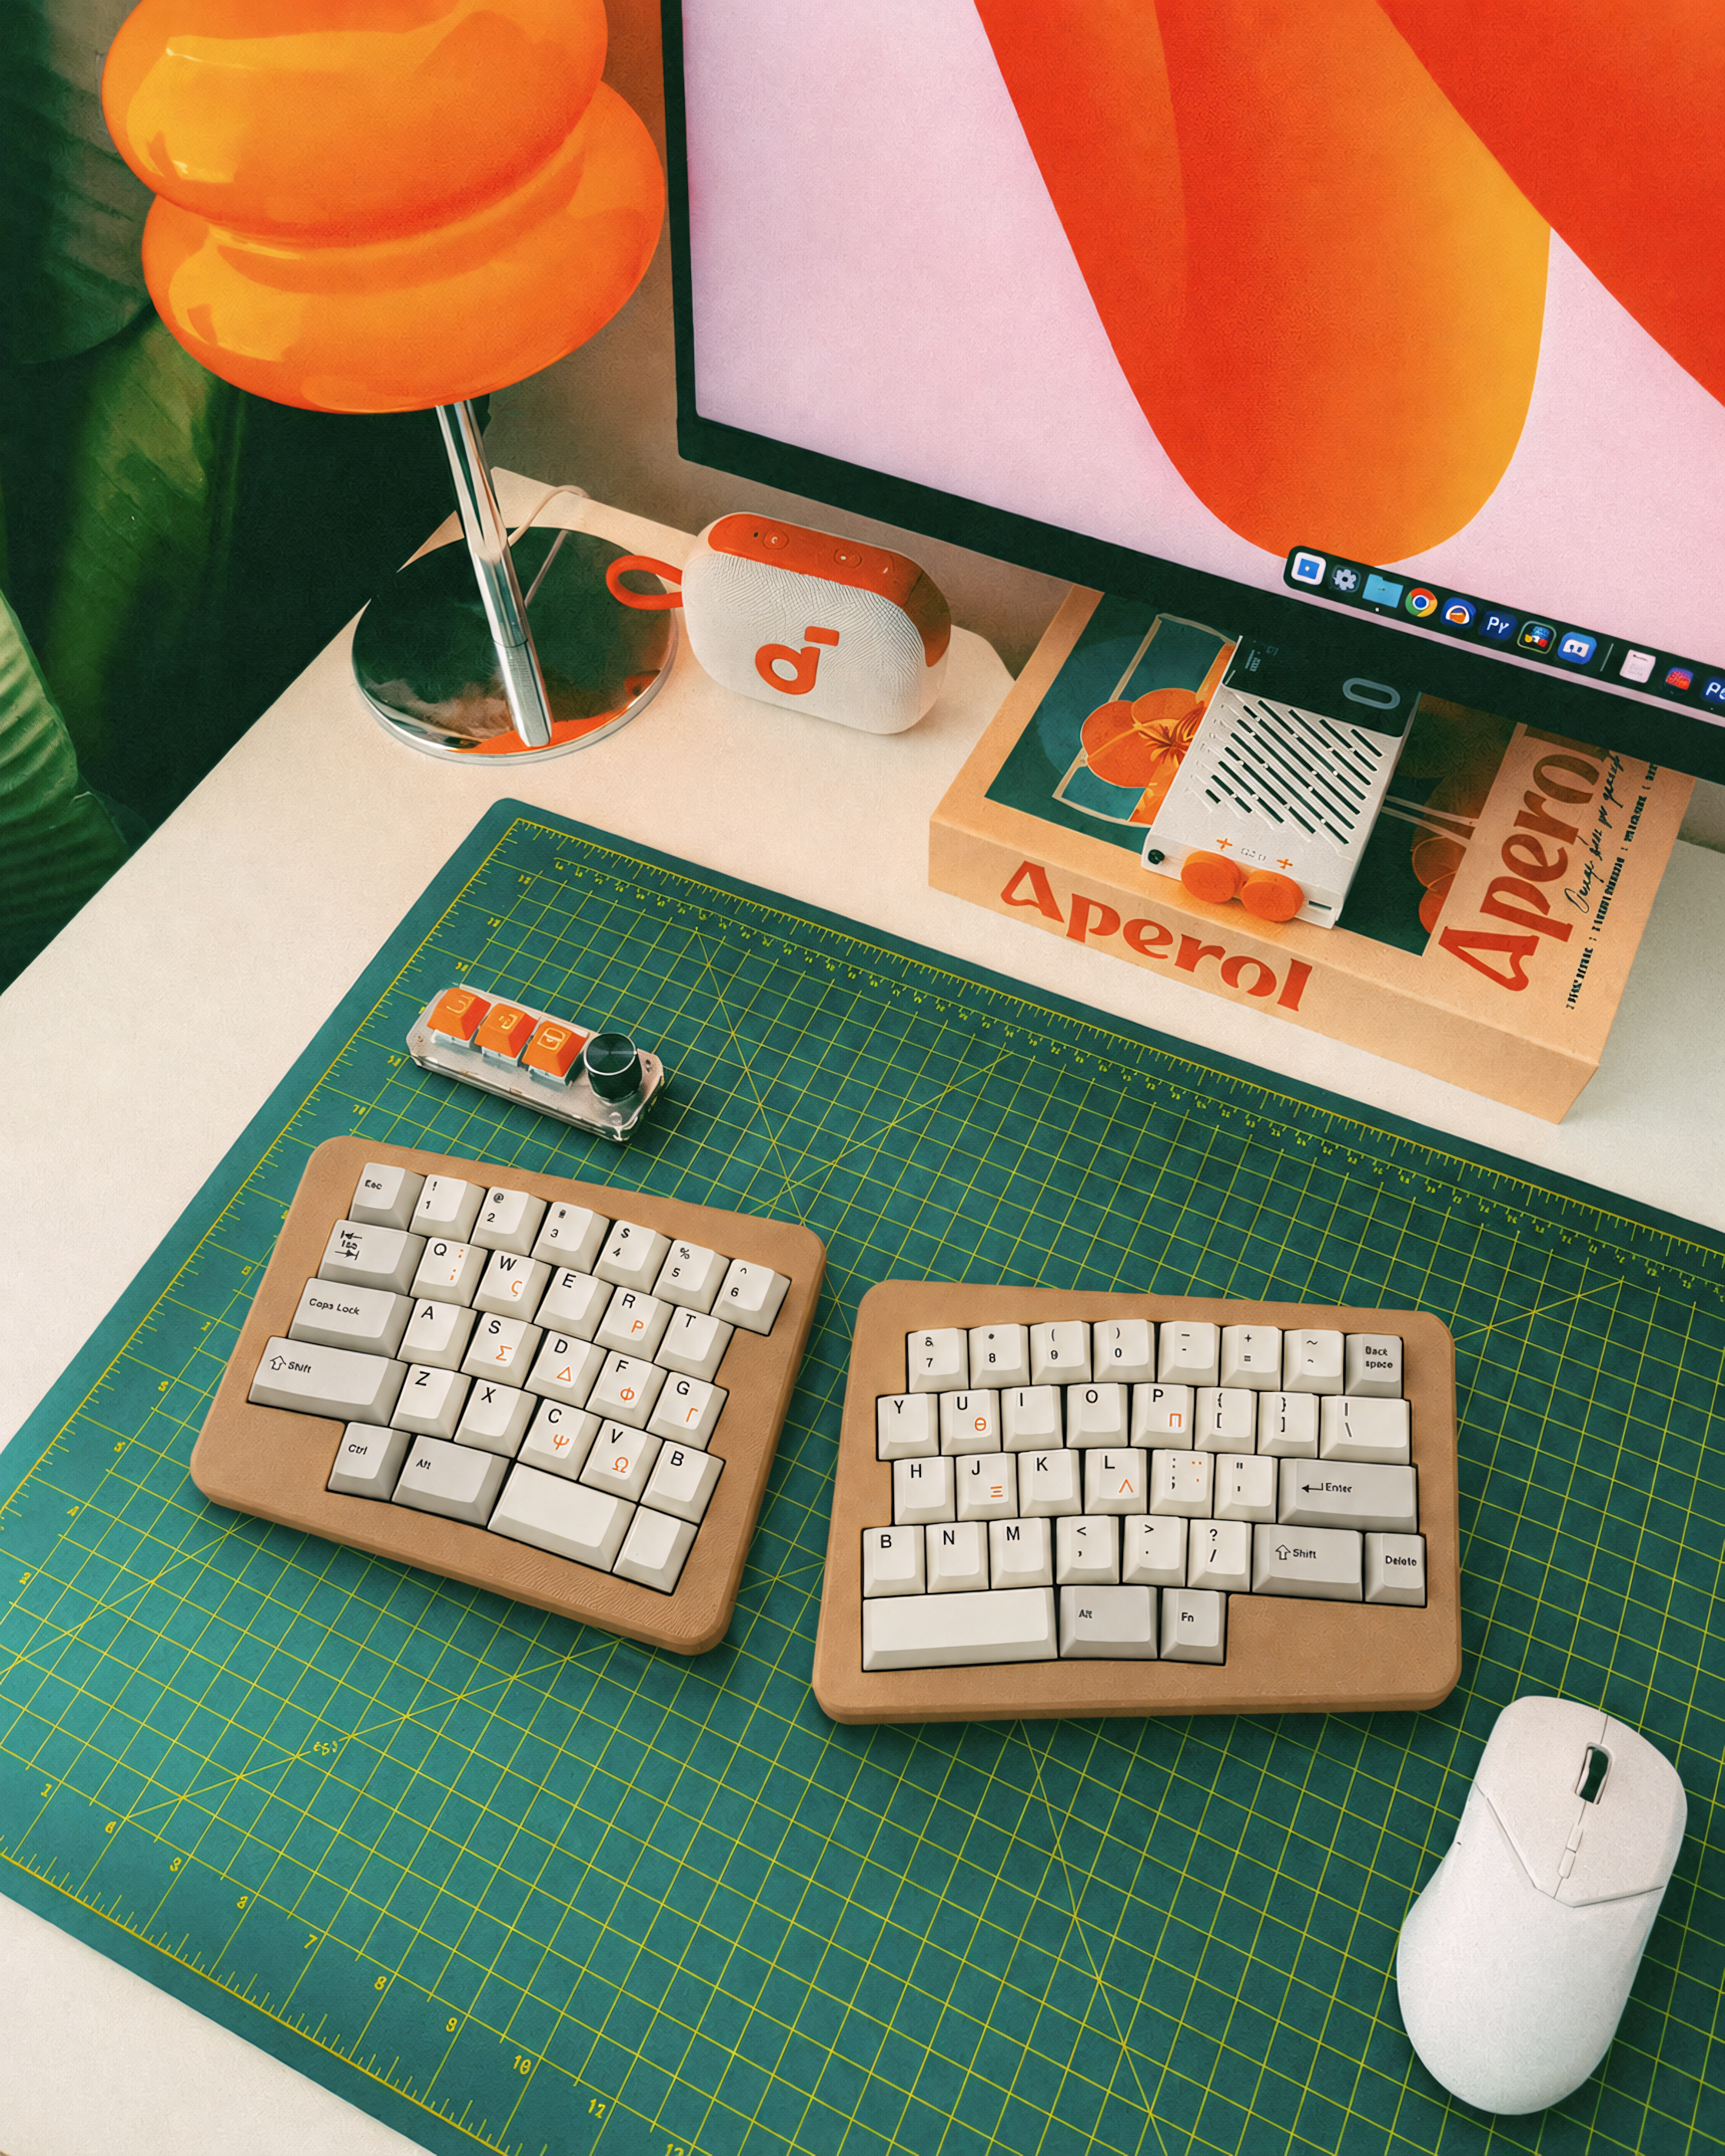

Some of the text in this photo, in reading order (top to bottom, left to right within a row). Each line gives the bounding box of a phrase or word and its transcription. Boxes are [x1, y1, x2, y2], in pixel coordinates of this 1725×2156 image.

[1000, 860, 1313, 1012] Aperol
[487, 1212, 496, 1223] 2
[550, 1228, 559, 1239] 3
[434, 1243, 447, 1257] Q
[500, 1255, 518, 1272] W
[671, 1267, 681, 1278] 5
[561, 1273, 577, 1289] E
[730, 1286, 740, 1297] 6
[621, 1293, 636, 1309] R
[336, 1303, 361, 1316] Lock
[420, 1306, 434, 1320] A
[488, 1319, 501, 1335] S
[685, 1313, 697, 1328] T
[553, 1338, 568, 1354] D
[1114, 1347, 1122, 1359] 0
[926, 1357, 934, 1368] 7
[989, 1352, 996, 1363] 8
[615, 1359, 630, 1372] F
[414, 1370, 431, 1387] Z
[480, 1386, 497, 1404] X
[676, 1380, 690, 1396] G
[1152, 1388, 1164, 1402] P
[956, 1396, 968, 1411] U
[1085, 1389, 1098, 1404] O
[893, 1399, 904, 1415] Y
[547, 1408, 563, 1424] C
[611, 1428, 624, 1444] V
[347, 1443, 368, 1456] Ctrl
[670, 1450, 685, 1467] B
[1036, 1456, 1049, 1472] K
[1104, 1455, 1115, 1469] L
[910, 1463, 922, 1479] H
[971, 1459, 981, 1476] J
[1006, 1526, 1020, 1542] M
[1076, 1526, 1087, 1536] <
[1144, 1524, 1155, 1534] >
[1209, 1528, 1218, 1542] ?
[880, 1534, 892, 1549] B
[942, 1529, 955, 1545] N
[1209, 1549, 1218, 1563] /
[1181, 1612, 1195, 1622] Fn
[304, 1934, 318, 1948] 7
[374, 1976, 387, 1990] 8
[446, 2017, 458, 2032] 9
[513, 2055, 531, 2074] 10
